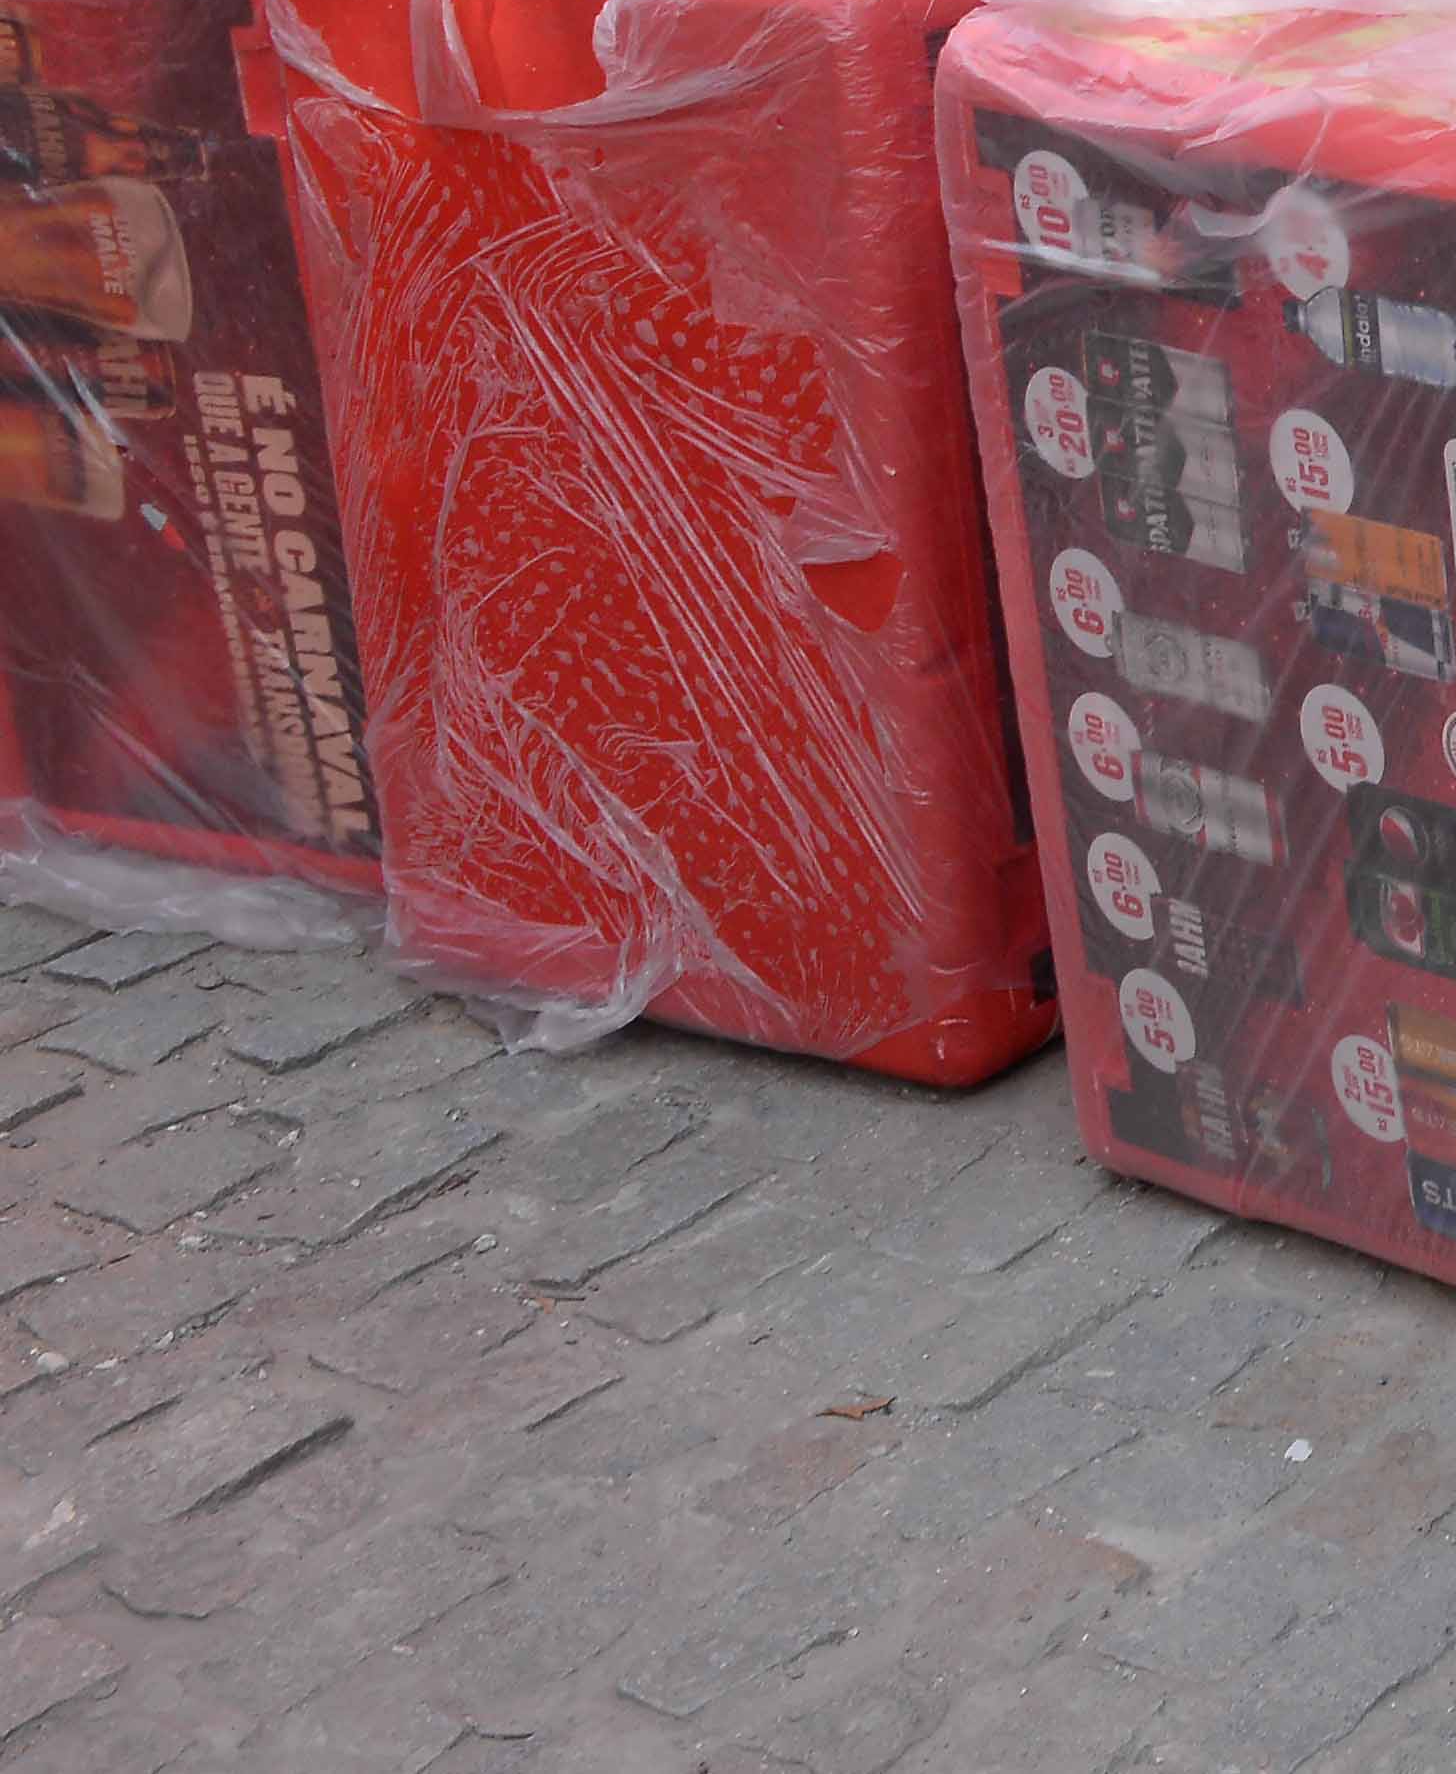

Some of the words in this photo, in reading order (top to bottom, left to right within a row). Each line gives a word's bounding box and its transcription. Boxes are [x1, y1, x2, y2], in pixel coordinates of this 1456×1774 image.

[242, 374, 296, 417] É
[253, 425, 305, 517] NO
[275, 529, 370, 843] CARNAVAL
